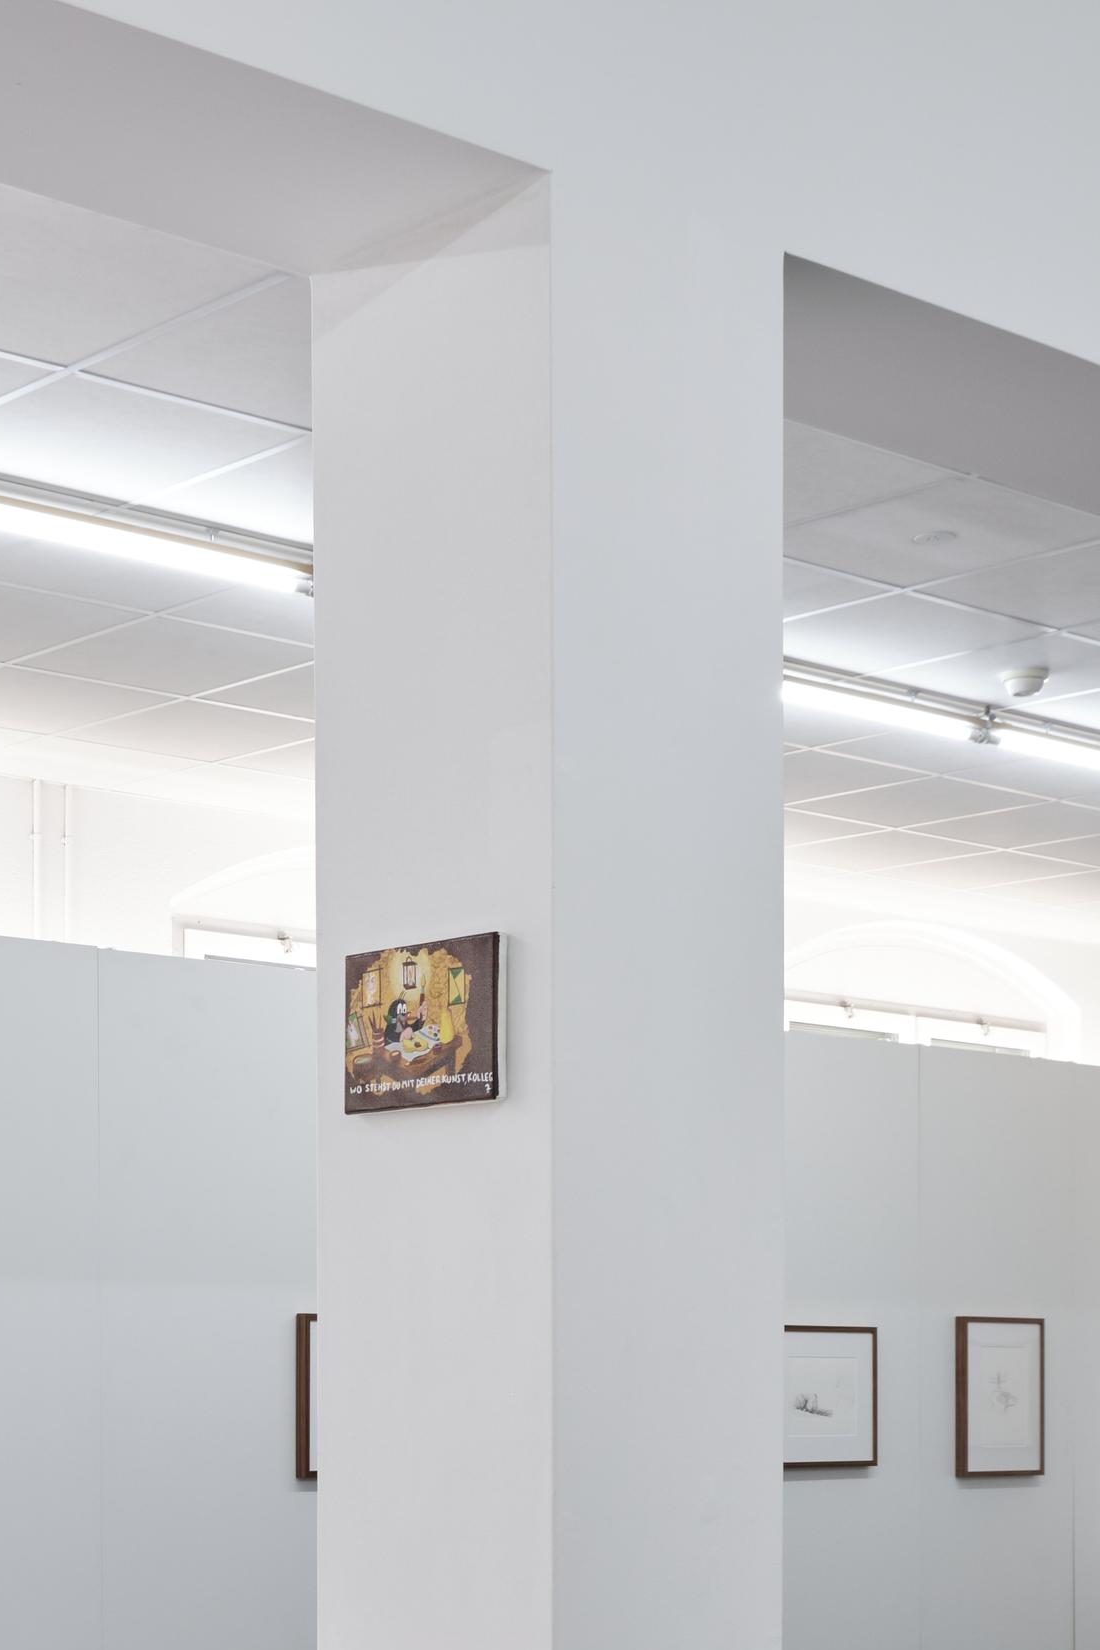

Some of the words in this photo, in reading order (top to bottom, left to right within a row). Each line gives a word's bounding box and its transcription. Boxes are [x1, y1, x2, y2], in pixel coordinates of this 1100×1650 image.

[350, 1085, 362, 1094] WO
[365, 1082, 391, 1092] STEHST
[401, 1079, 414, 1088] MIT
